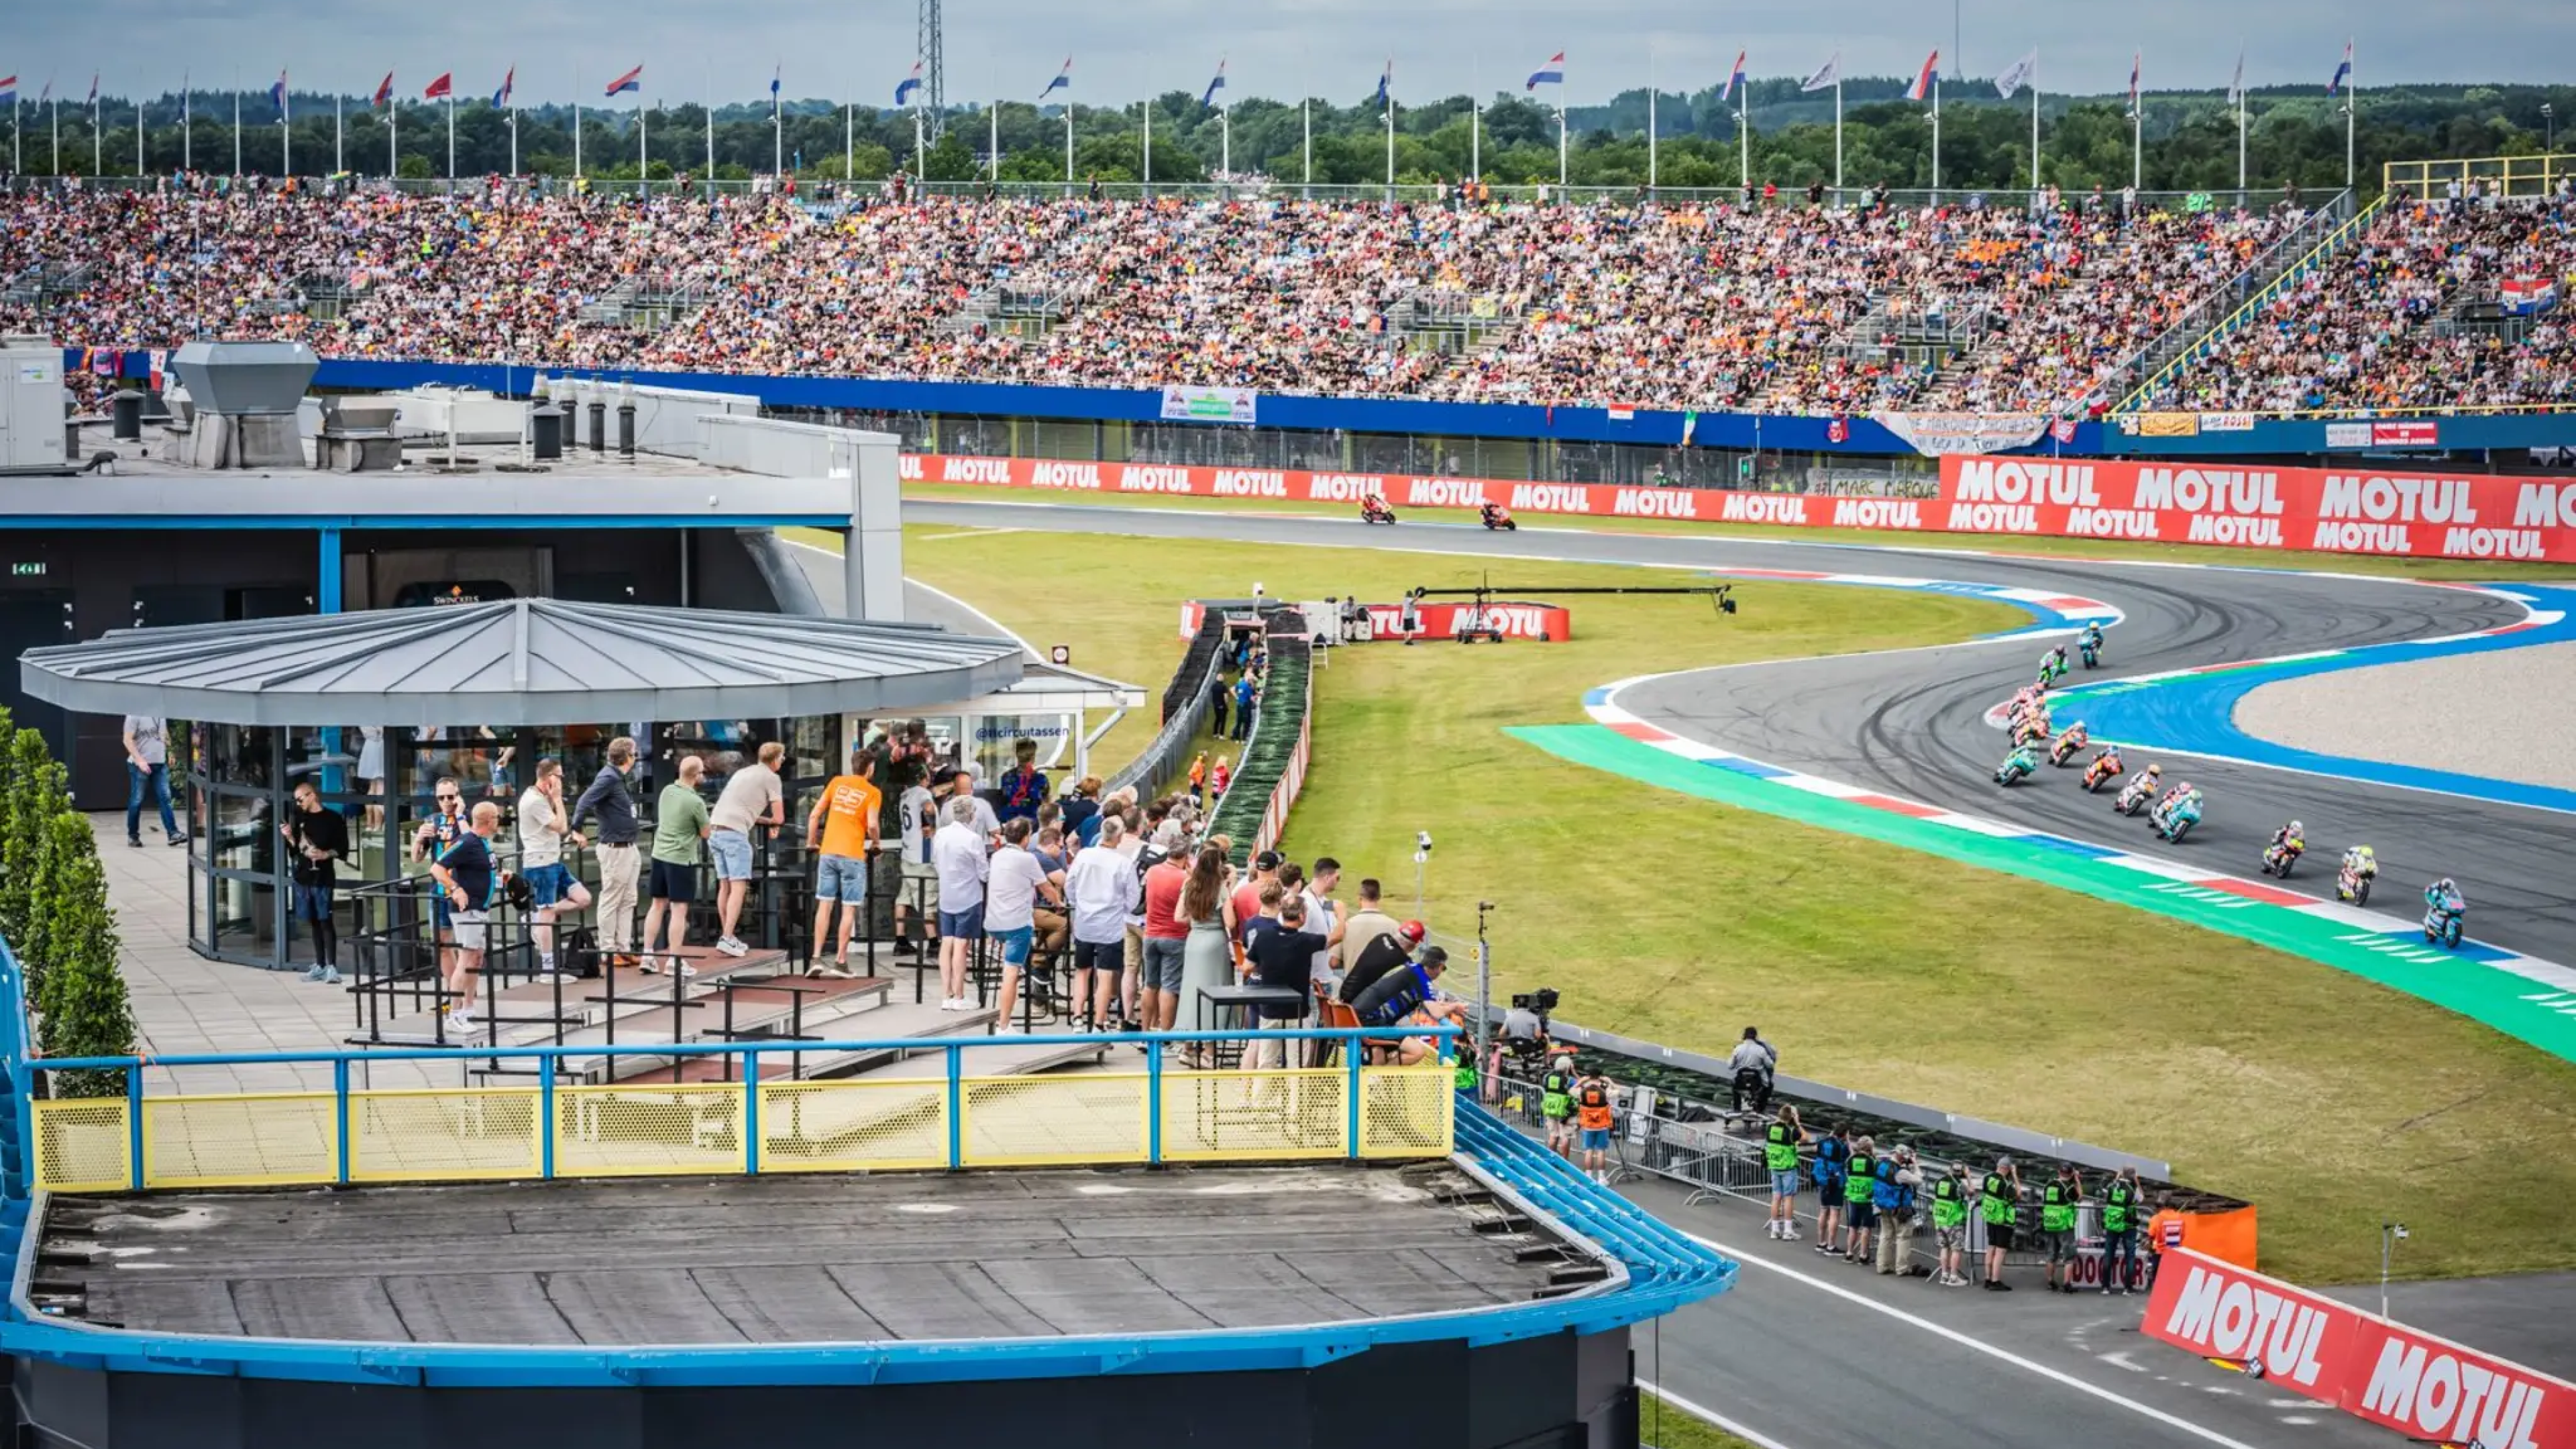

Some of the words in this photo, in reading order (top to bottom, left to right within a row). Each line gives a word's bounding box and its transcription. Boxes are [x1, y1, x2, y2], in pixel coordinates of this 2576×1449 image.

[943, 457, 1011, 484] MOTUL
[1031, 460, 1101, 488] MOTUL
[1120, 466, 1191, 492] MOTUL
[1213, 470, 1287, 496] MOTUL
[1956, 460, 2100, 506] MOTUL
[1309, 474, 1385, 500] MOTUL
[1409, 478, 1491, 508] MOTUL
[1511, 484, 1590, 512] MOTUL
[1835, 479, 1876, 498] MARC
[2133, 468, 2284, 514] MOTUL
[2319, 476, 2475, 523] MOTUL
[1614, 489, 1697, 517] MOTUL
[1722, 494, 1807, 523] MOTUL
[1833, 500, 1922, 528] MOTUL
[1948, 504, 2038, 531] MOTUL
[2066, 508, 2159, 537] MOTUL
[2188, 515, 2283, 545] MOTUL
[2314, 522, 2411, 551] MOTUL
[2444, 528, 2544, 558] MOTUL
[2165, 1266, 2329, 1387] MOTUL
[2361, 1336, 2545, 1449] MOTUL
